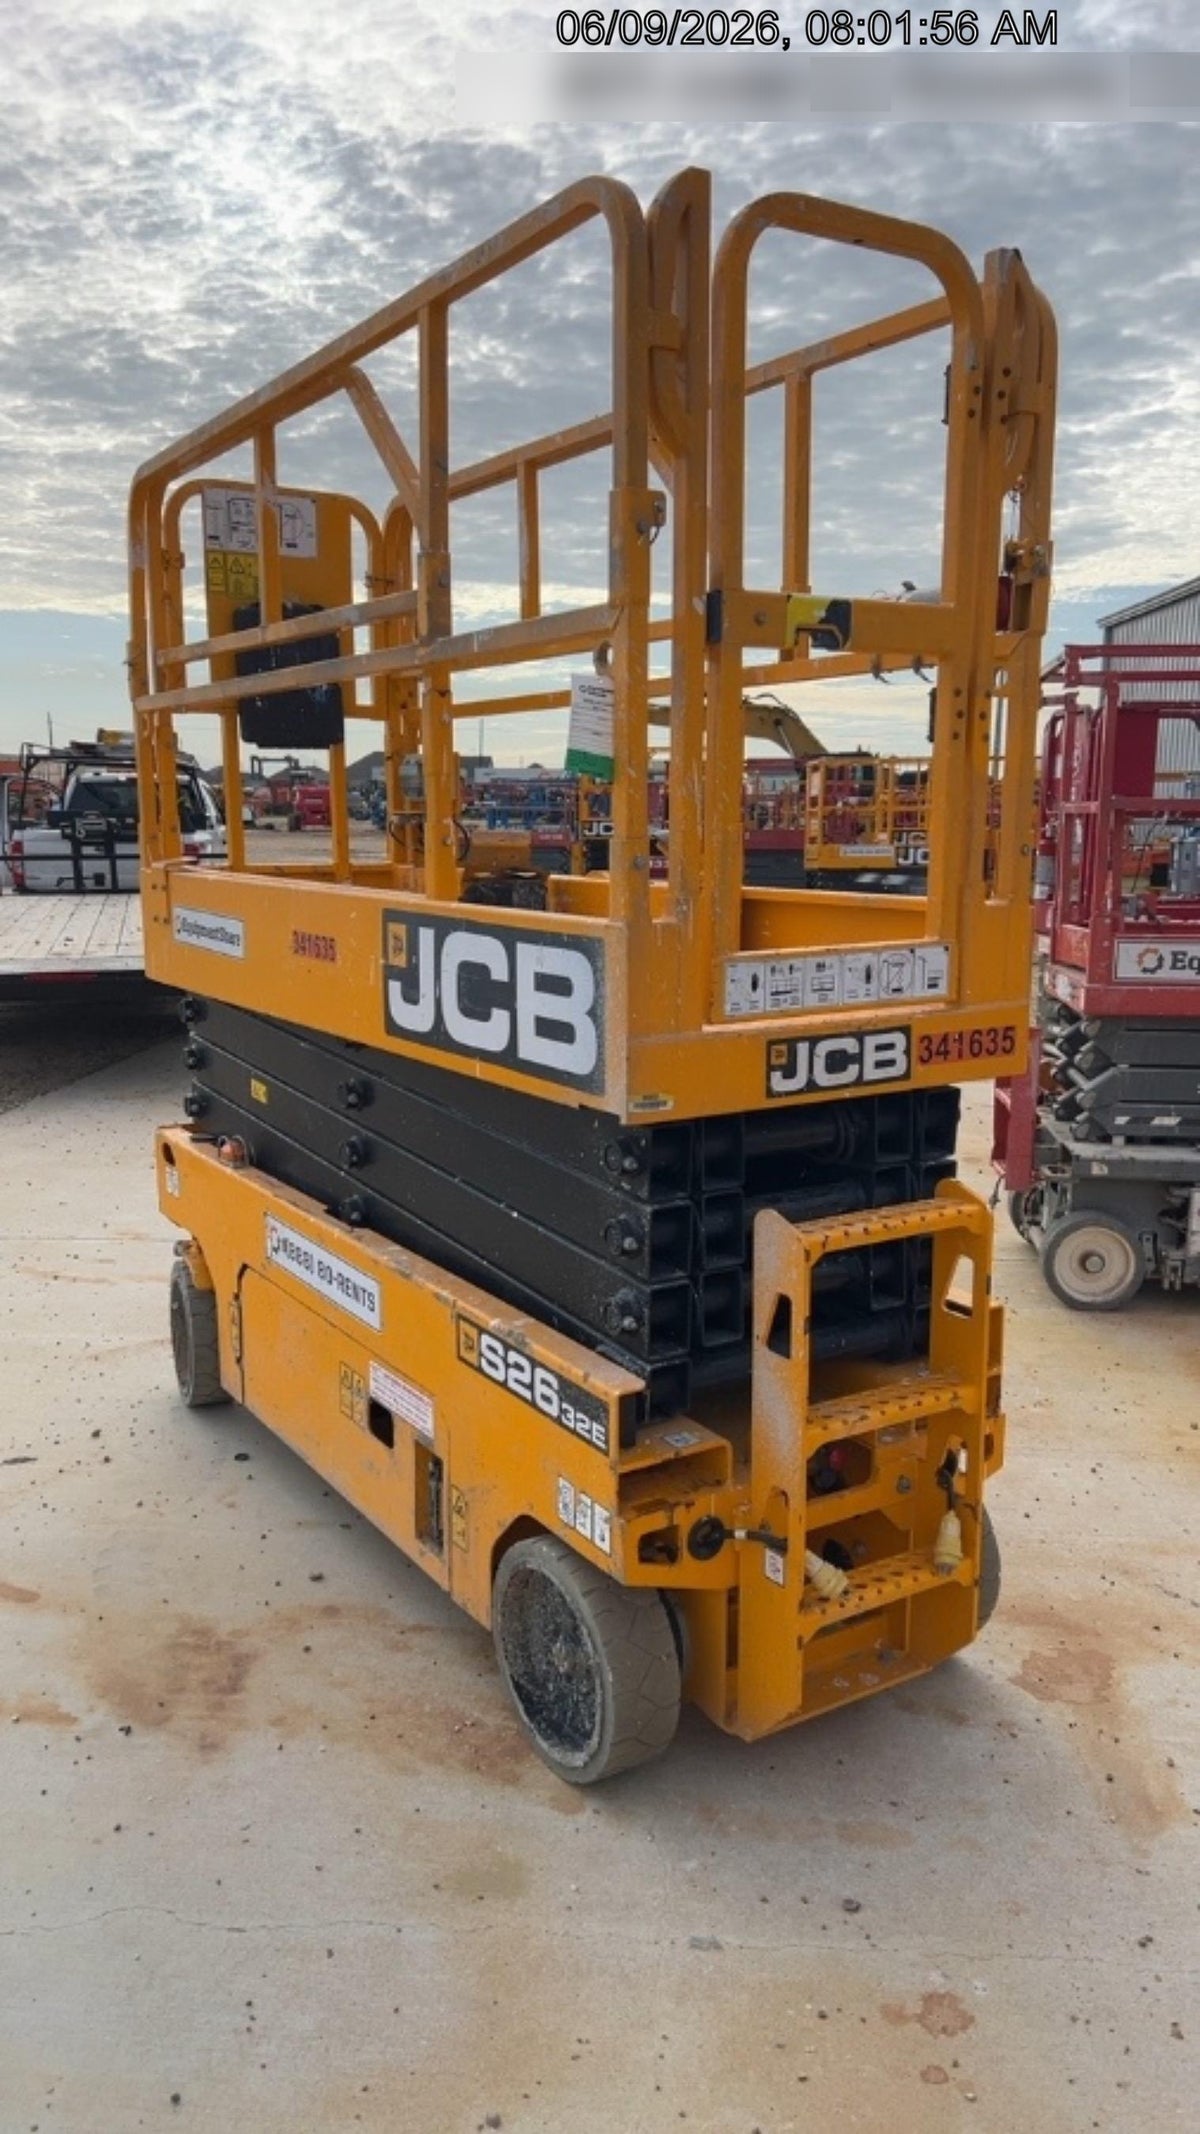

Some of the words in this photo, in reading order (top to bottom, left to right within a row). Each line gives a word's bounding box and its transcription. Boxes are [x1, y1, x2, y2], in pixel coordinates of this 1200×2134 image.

[583, 822, 615, 836] JC
[898, 848, 930, 865] JC
[1169, 950, 1200, 975] Eq
[388, 926, 599, 1076] JCB
[770, 1031, 909, 1093] JCB
[919, 1026, 1016, 1064] 341635
[317, 1260, 376, 1313] 80-RENTS
[480, 1333, 561, 1417] S26
[561, 1402, 608, 1450] 32E
